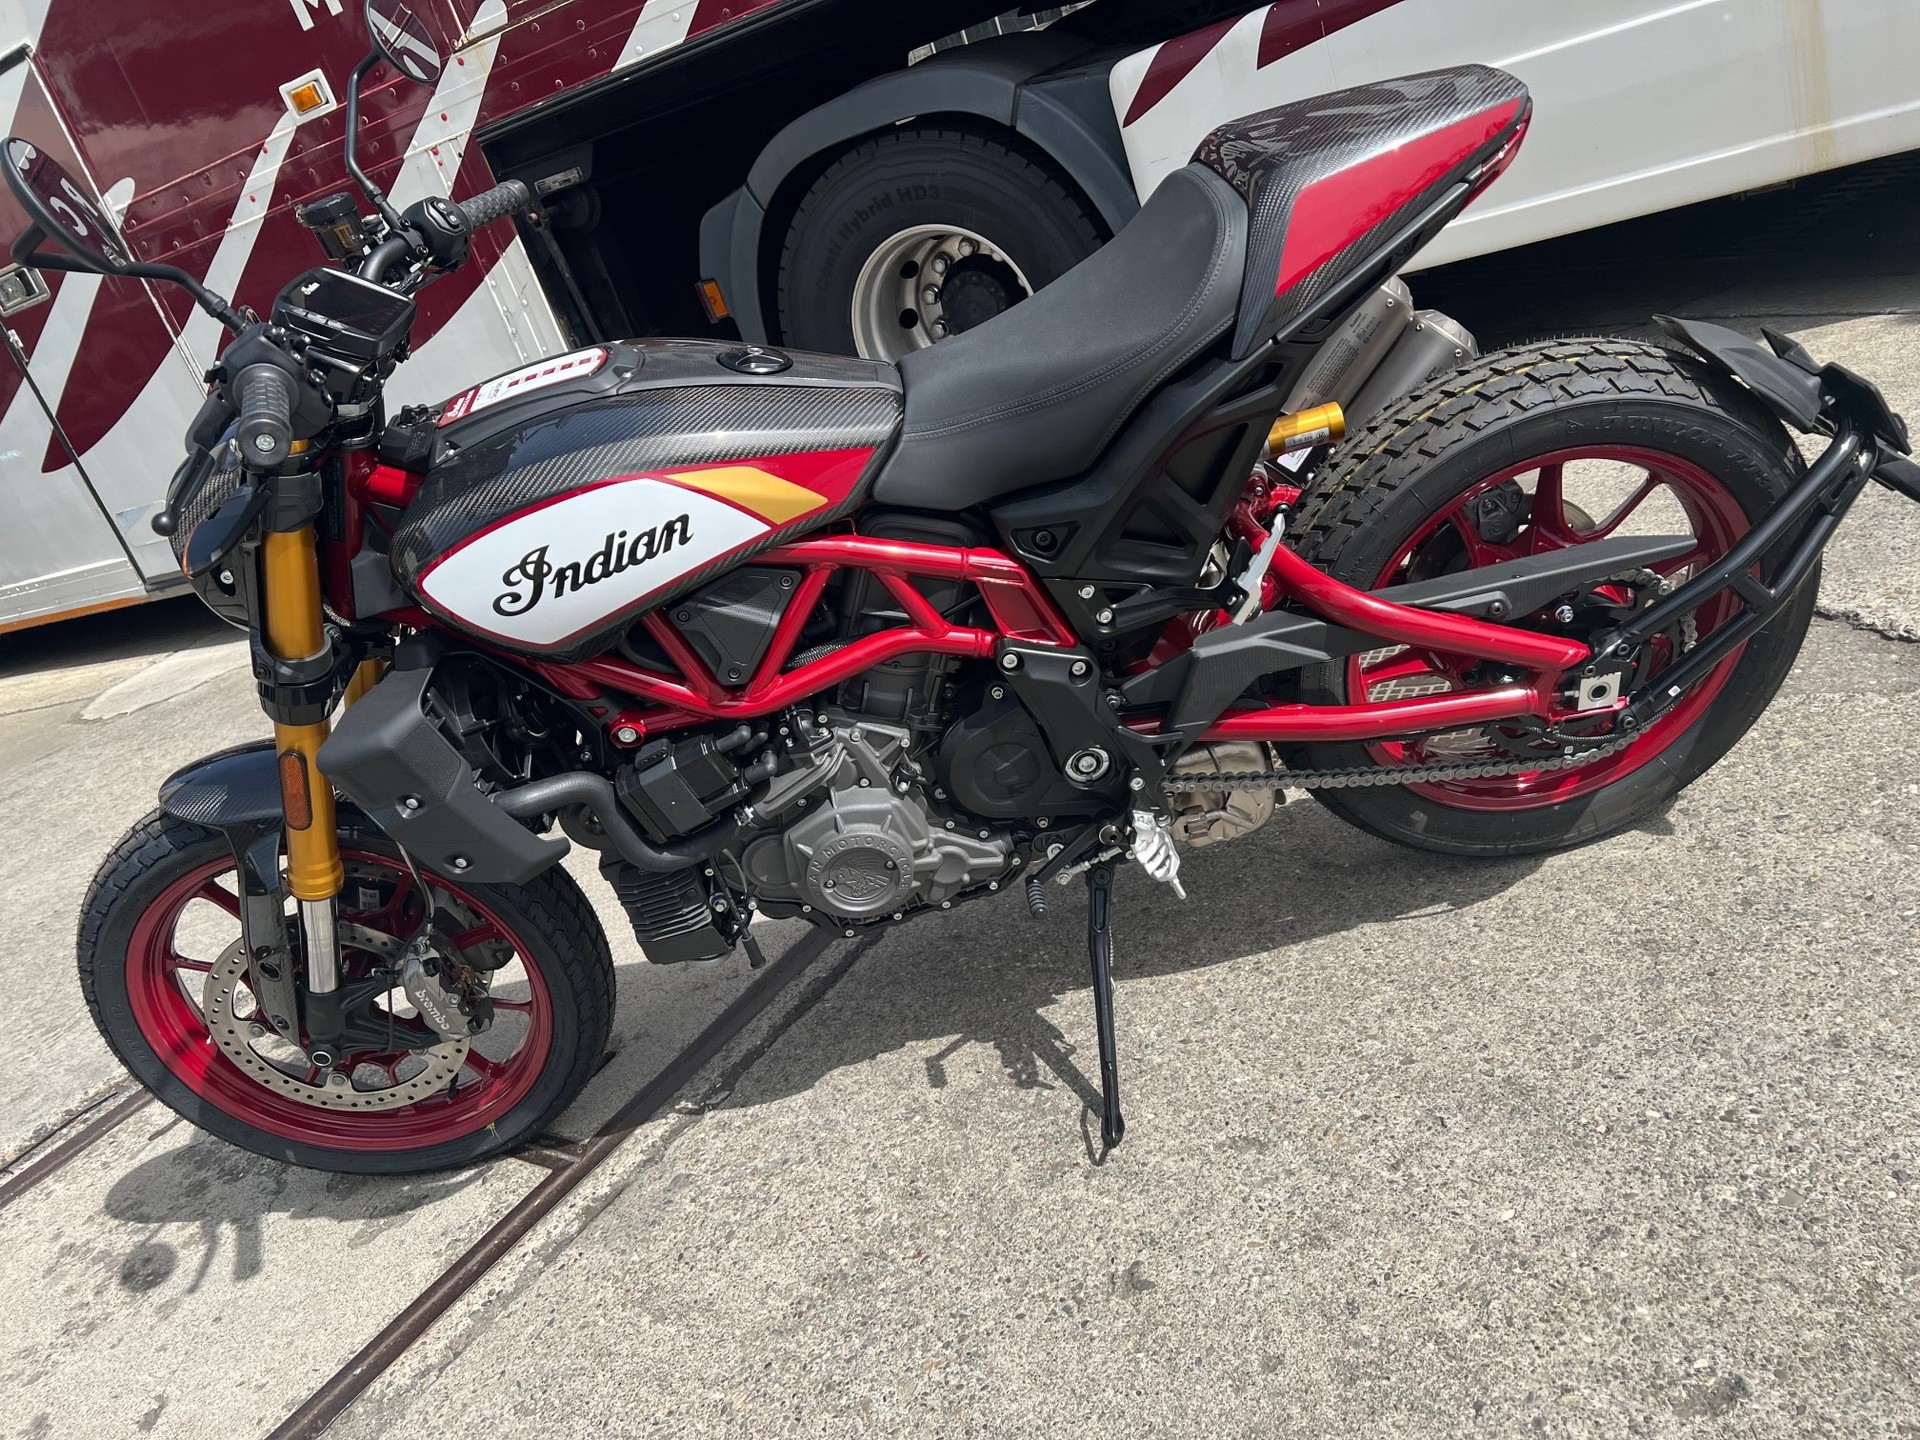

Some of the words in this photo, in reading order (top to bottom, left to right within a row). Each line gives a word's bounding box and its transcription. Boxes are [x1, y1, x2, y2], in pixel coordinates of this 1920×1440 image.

[836, 191, 894, 240] Hybrid
[896, 184, 940, 202] HD3
[492, 513, 695, 617] Indian
[414, 988, 451, 1030] brembo
